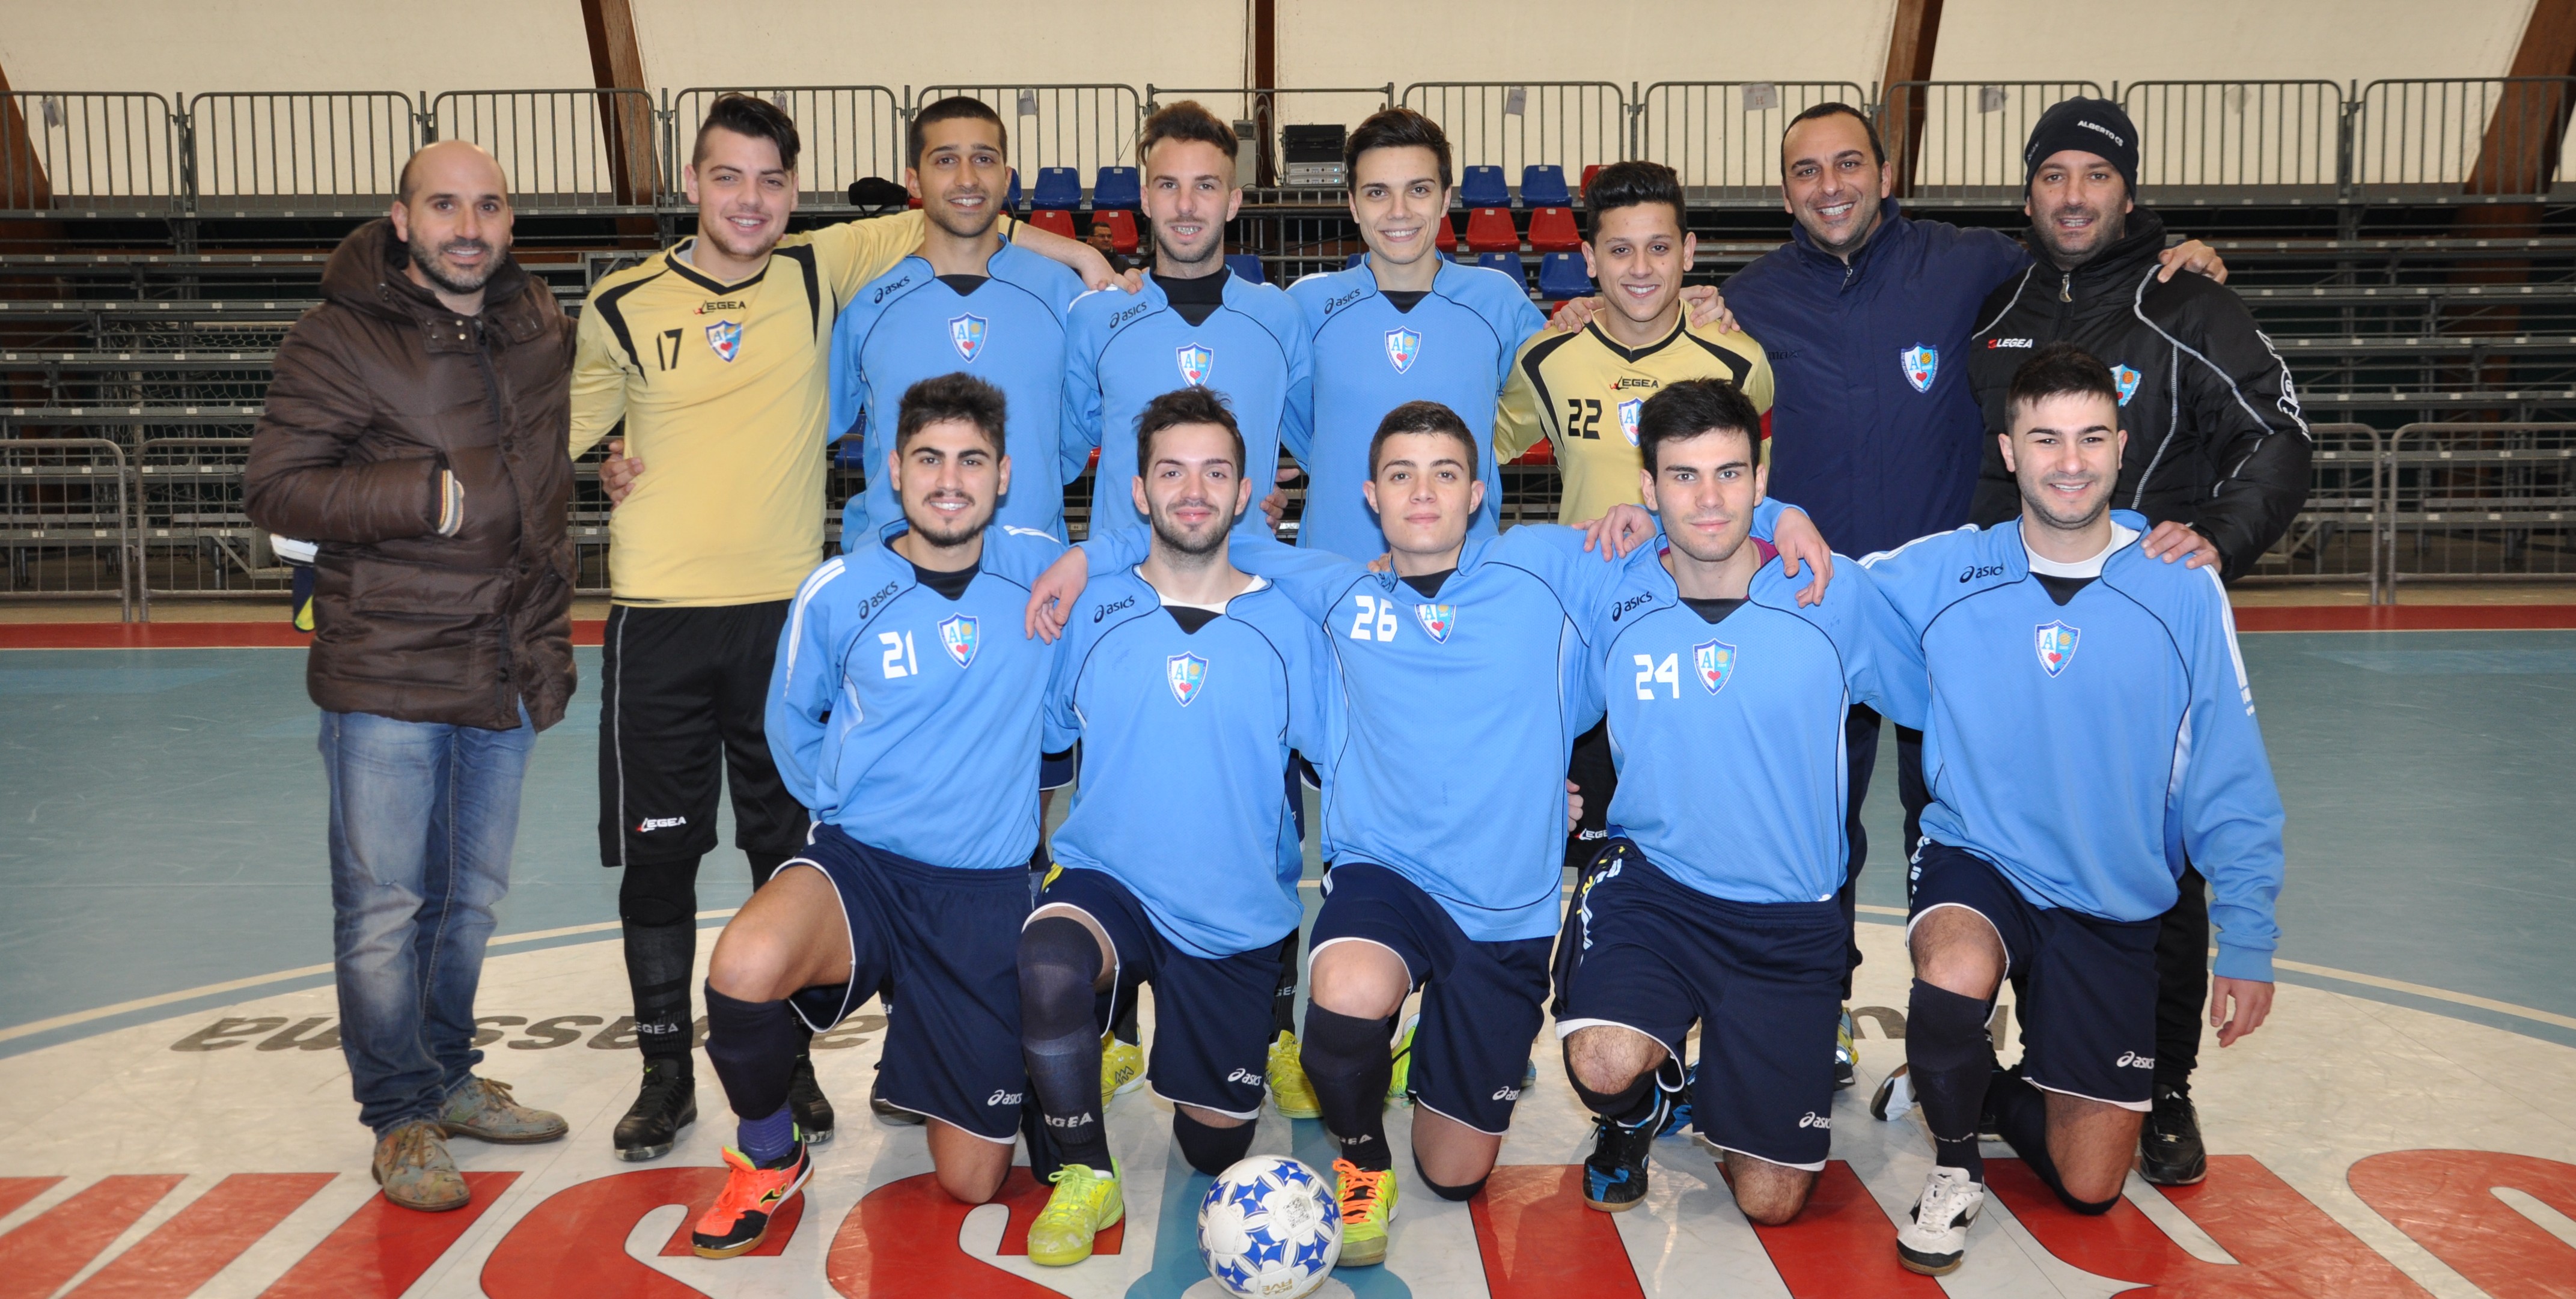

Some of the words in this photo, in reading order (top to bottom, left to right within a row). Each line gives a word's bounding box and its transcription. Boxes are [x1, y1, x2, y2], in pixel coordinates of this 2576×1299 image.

[885, 276, 910, 294] asics
[1335, 288, 1361, 307] asics
[700, 300, 746, 314] LEGEA
[1122, 302, 1147, 321] asics
[956, 324, 967, 339] A
[656, 328, 683, 371] 17
[1391, 336, 1401, 351] A
[1996, 338, 2033, 348] LEGEA
[1184, 353, 1194, 368] A
[1909, 354, 1919, 371] A
[1616, 376, 1659, 391] LEGEA
[1567, 398, 1603, 440] 22
[1624, 409, 1635, 424] A
[871, 581, 899, 607] asics
[1624, 591, 1652, 612] asics
[1106, 595, 1135, 615] asics
[1424, 604, 1436, 621] A
[1350, 595, 1398, 642] 26
[948, 625, 960, 643] A
[2042, 632, 2054, 650] A
[877, 630, 918, 679] 21
[1700, 651, 1713, 668] A
[1174, 663, 1185, 680] A
[1633, 653, 1680, 700] 24
[641, 816, 686, 833] LEGEA
[1579, 828, 1608, 841] LEGE
[636, 1022, 679, 1034] EGEA
[1262, 1279, 1293, 1291] FIVE
